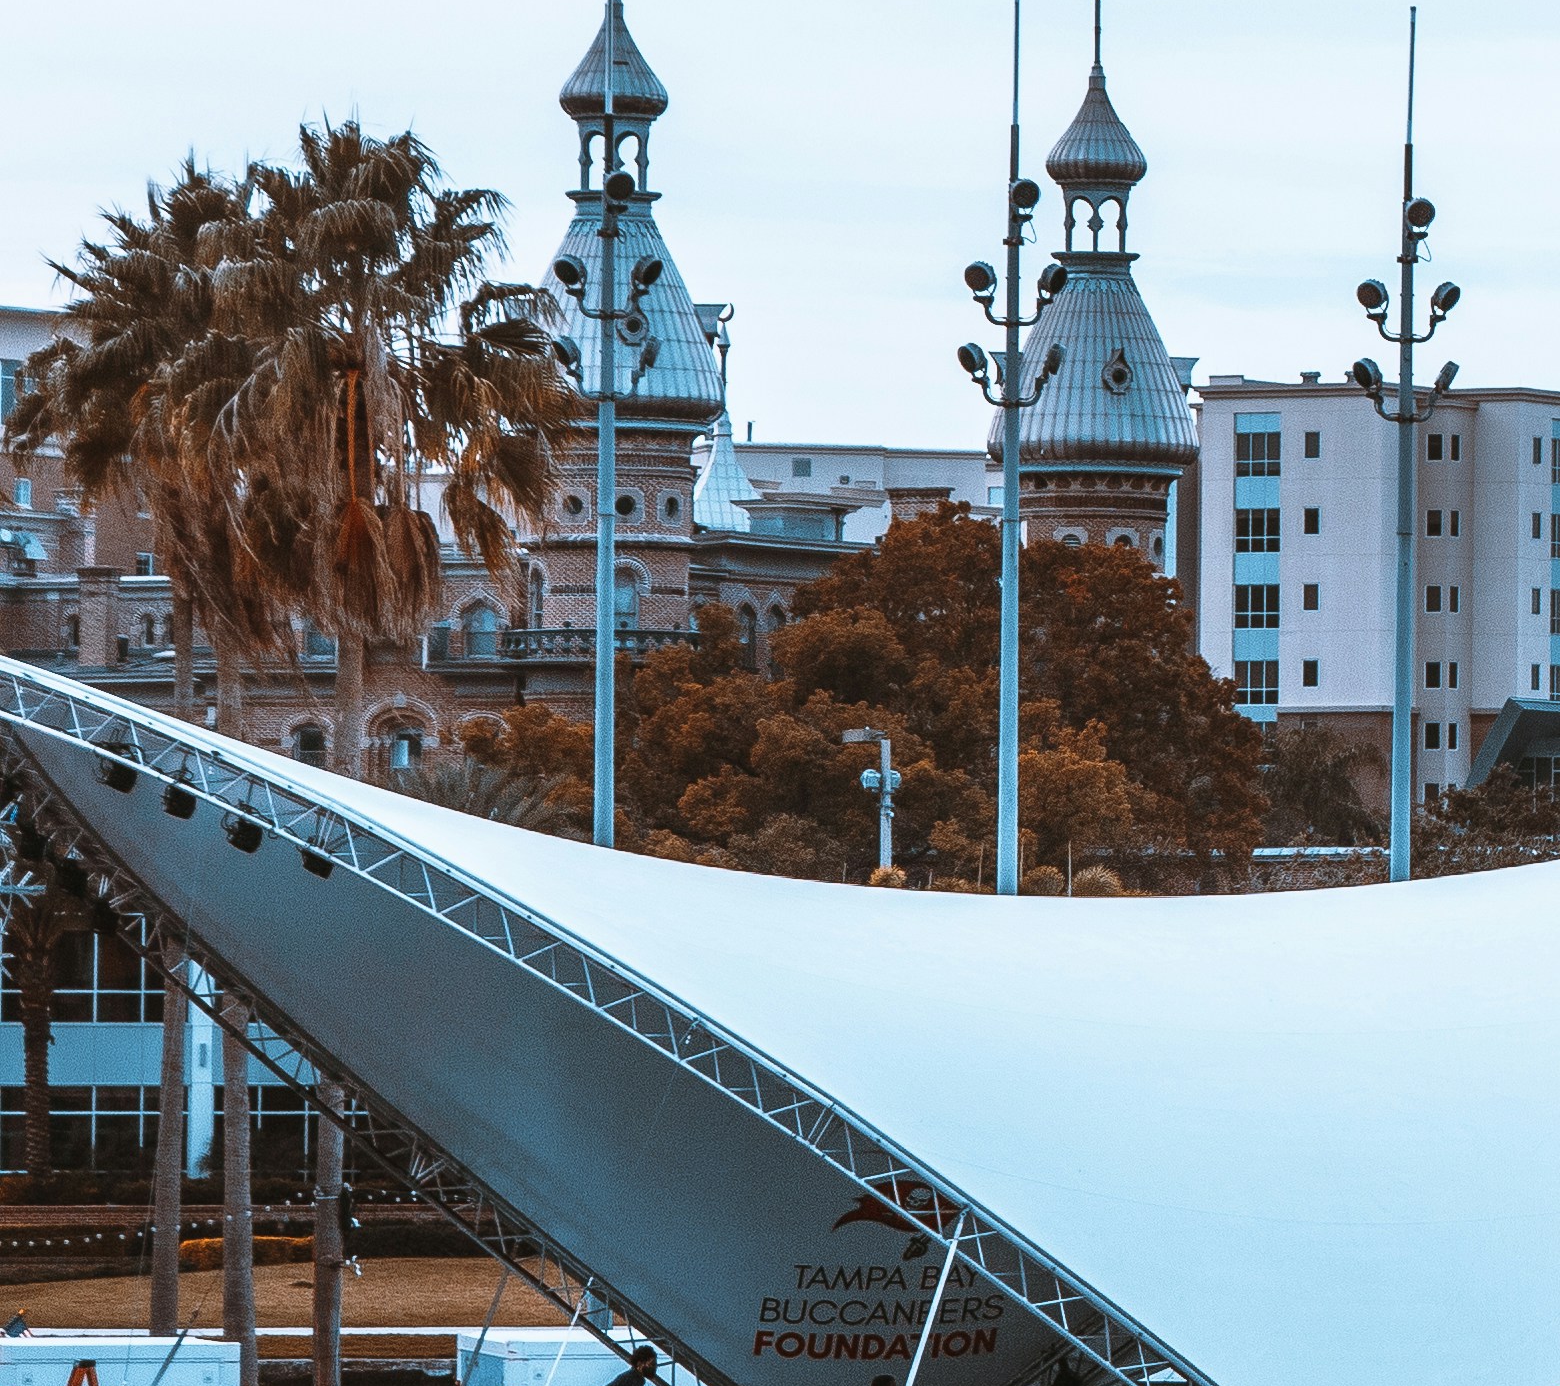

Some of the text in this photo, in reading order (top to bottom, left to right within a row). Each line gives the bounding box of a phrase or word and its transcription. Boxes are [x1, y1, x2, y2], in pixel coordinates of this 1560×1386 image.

[794, 1264, 979, 1291] TAMPA BAY
[759, 1294, 1005, 1326] BUCCANEERS
